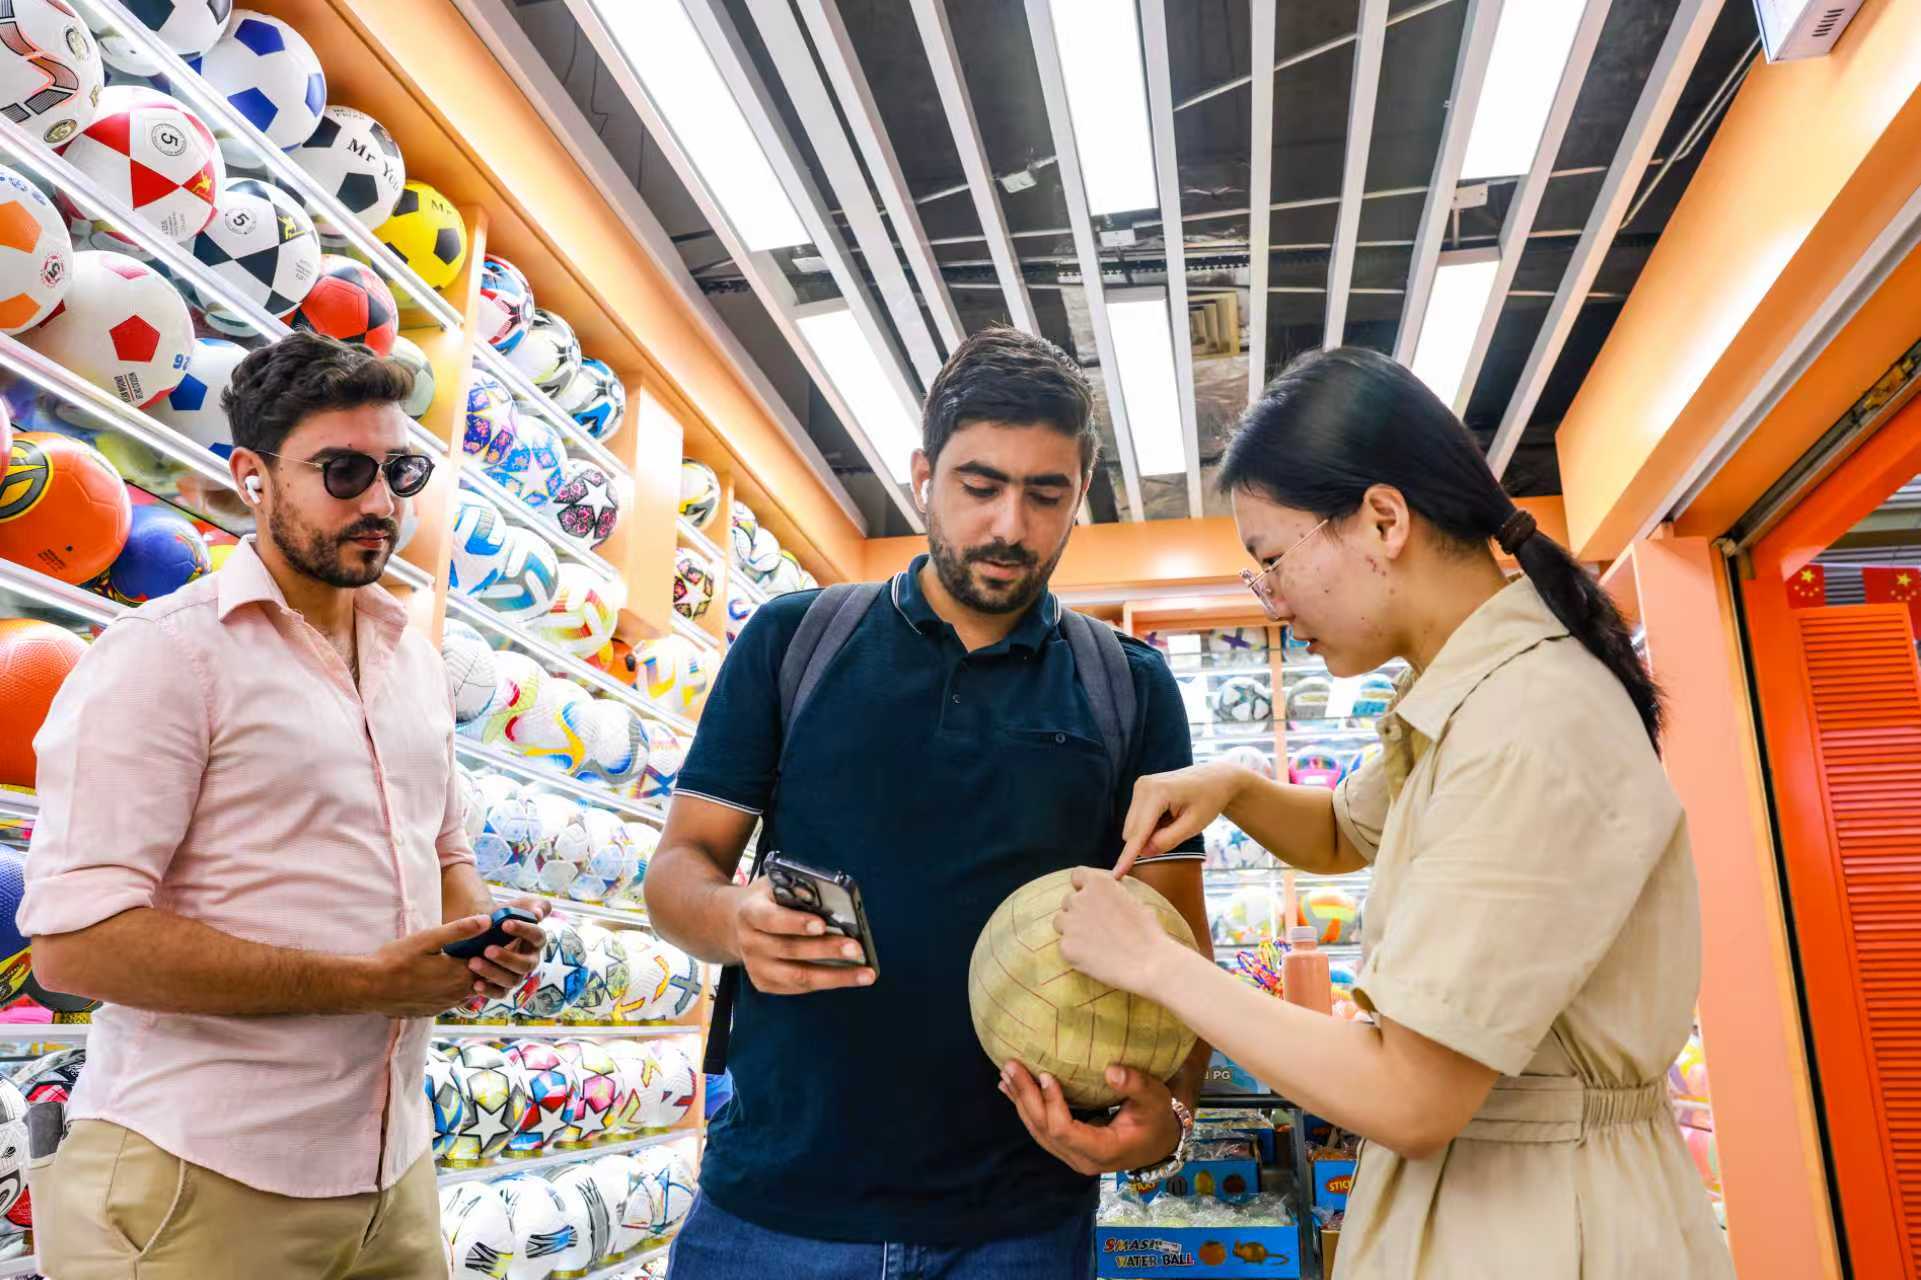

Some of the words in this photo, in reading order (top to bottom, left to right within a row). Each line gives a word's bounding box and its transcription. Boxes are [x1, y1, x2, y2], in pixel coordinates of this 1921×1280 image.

[161, 132, 178, 147] 5
[346, 137, 376, 163] Mr
[233, 212, 250, 227] 5
[1213, 1070, 1230, 1080] PG
[1115, 1255, 1158, 1267] WATER
[1162, 1252, 1195, 1266] BALL
